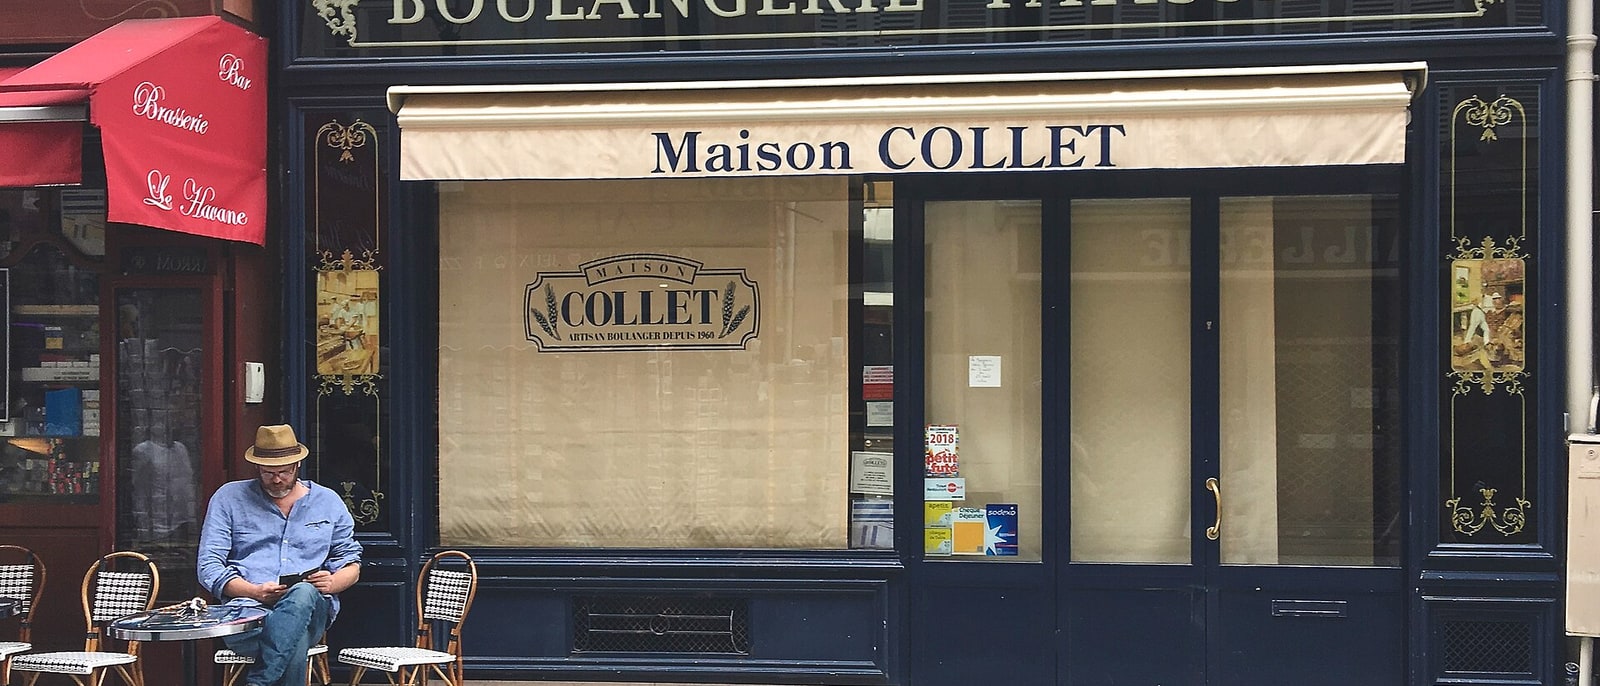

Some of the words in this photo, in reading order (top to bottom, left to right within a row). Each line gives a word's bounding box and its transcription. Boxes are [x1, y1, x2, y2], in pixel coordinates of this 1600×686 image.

[218, 53, 252, 91] Bar
[133, 82, 209, 135] Brasserie
[651, 130, 853, 173] Maison
[878, 124, 1126, 169] COLLET
[143, 169, 173, 210] Le
[180, 178, 248, 226] Havane
[596, 262, 687, 278] MAISON
[561, 289, 718, 327] COLLET
[568, 332, 605, 342] ARTISAN
[607, 331, 661, 341] BOULANGER
[663, 331, 695, 341] DEPUIS
[697, 330, 715, 340] 1960
[929, 433, 955, 445] 2018
[925, 452, 958, 465] petit
